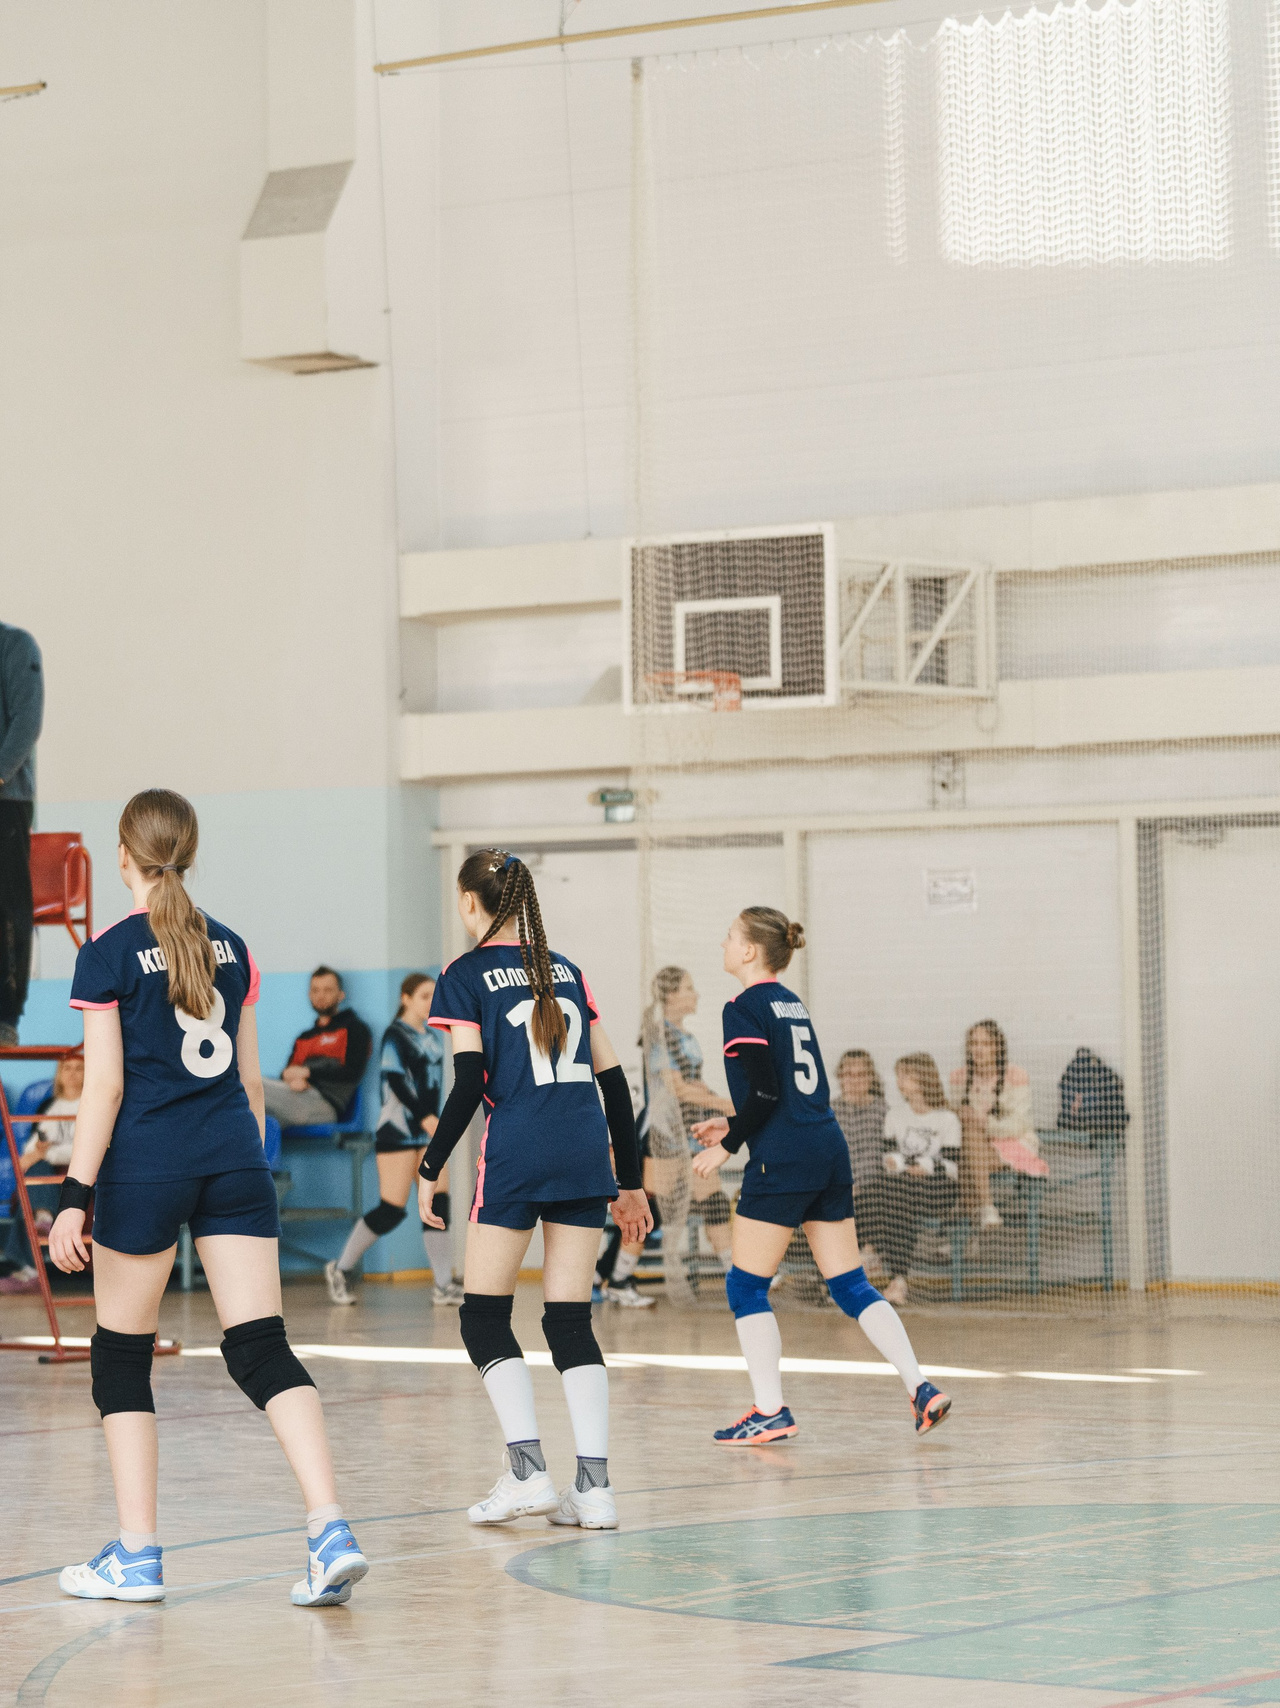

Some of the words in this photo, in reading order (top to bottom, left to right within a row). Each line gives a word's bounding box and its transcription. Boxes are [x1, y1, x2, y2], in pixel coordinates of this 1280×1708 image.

[136, 940, 238, 975] КОВА
[174, 985, 233, 1079] 8
[505, 997, 593, 1086] 12
[790, 1025, 819, 1096] 5
